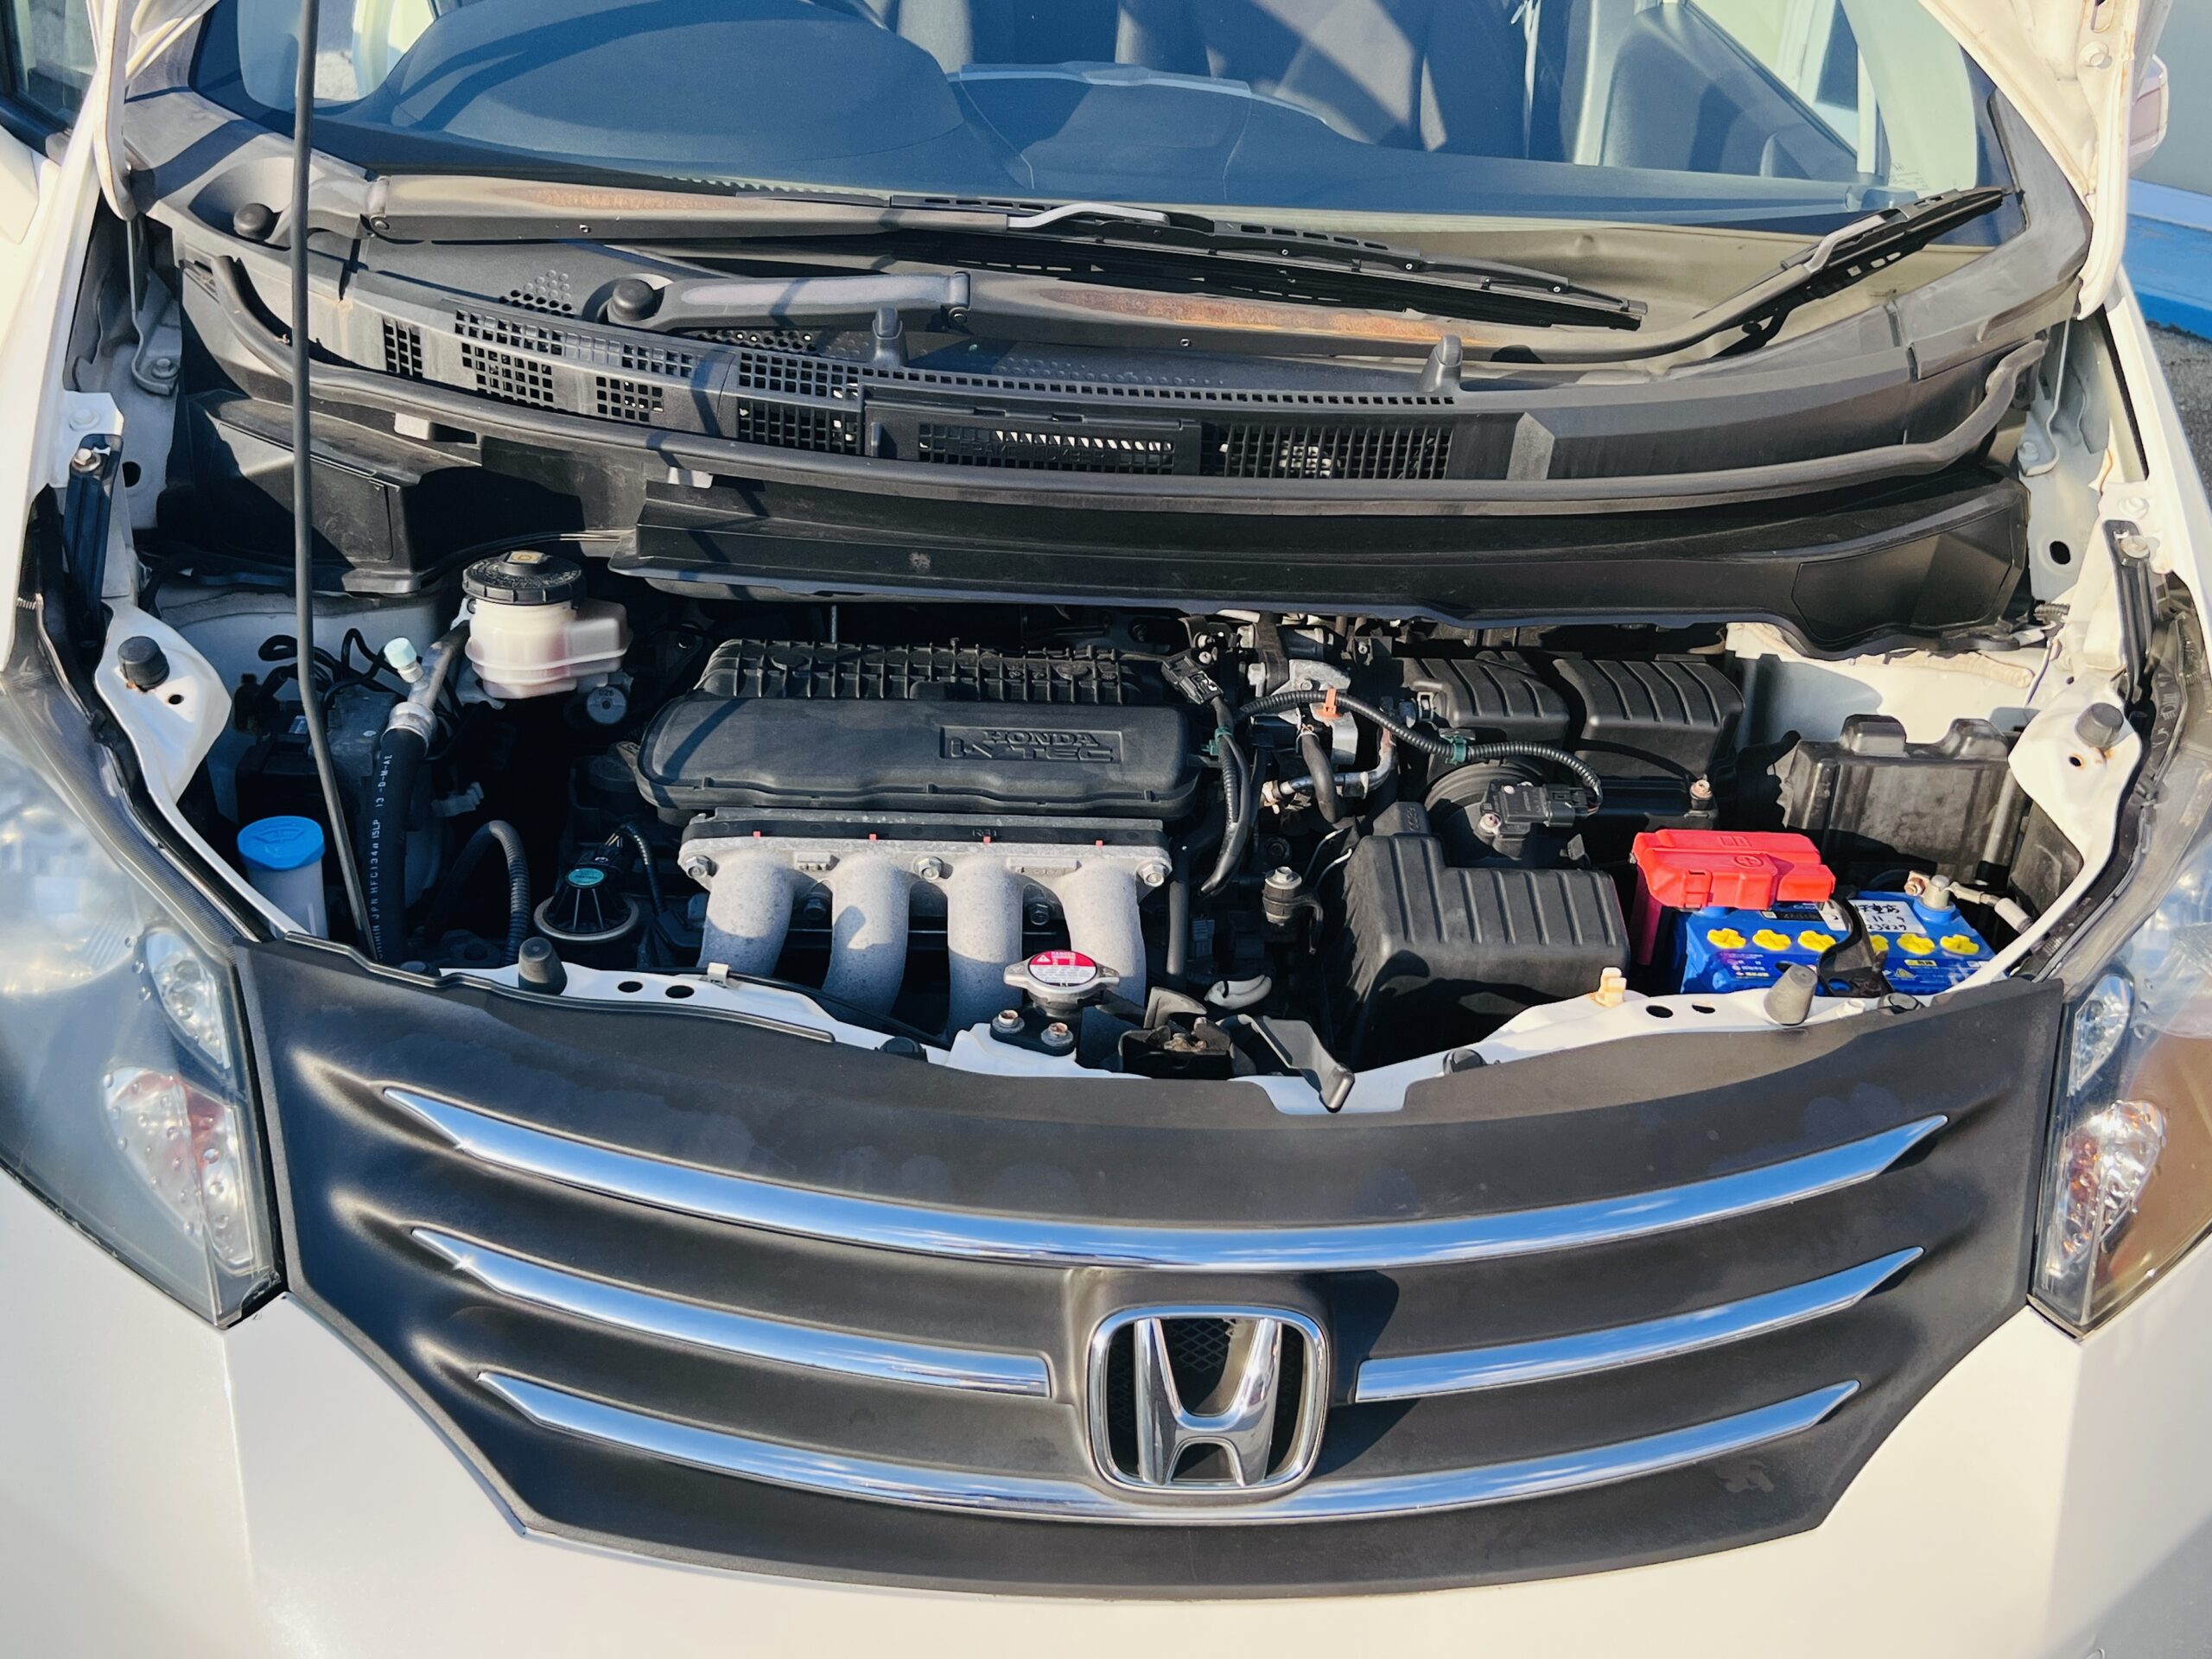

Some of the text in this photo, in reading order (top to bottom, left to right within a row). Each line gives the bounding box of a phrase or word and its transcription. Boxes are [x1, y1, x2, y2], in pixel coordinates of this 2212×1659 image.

[960, 441, 1105, 464] FRAME NUMBER
[982, 730, 1100, 747] HONDA
